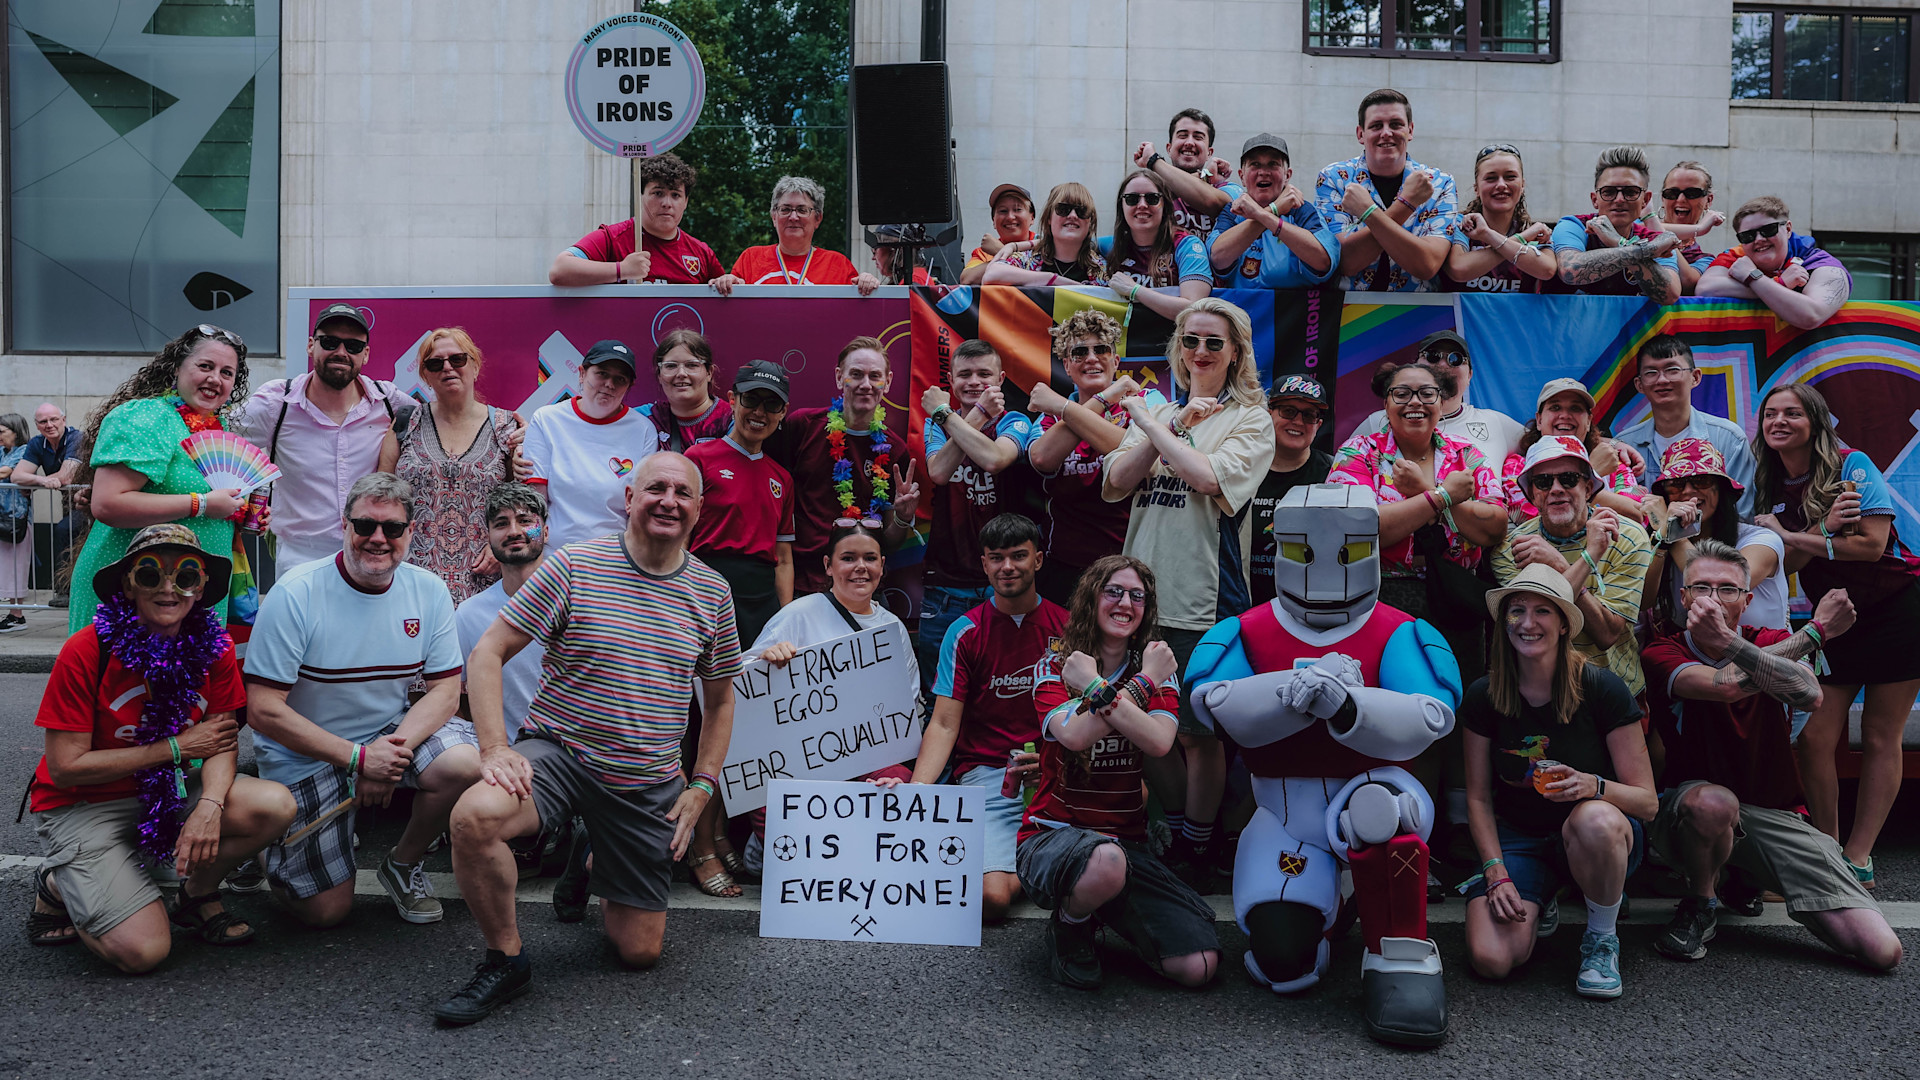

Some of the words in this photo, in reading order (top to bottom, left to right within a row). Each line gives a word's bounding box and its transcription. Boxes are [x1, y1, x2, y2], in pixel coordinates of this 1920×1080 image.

[583, 23, 606, 45] MANY
[606, 15, 638, 28] VOICES
[639, 16, 658, 27] ONE
[657, 21, 685, 43] FRONT
[597, 46, 671, 68] PRIDE
[618, 74, 650, 95] OF
[597, 101, 673, 122] IRONS
[1306, 290, 1320, 342] IRONS
[938, 326, 951, 393] AMMERS
[1305, 346, 1319, 368] OF
[753, 371, 781, 383] PELOTON
[1136, 491, 1187, 509] MTORS
[1260, 509, 1273, 518] AT
[733, 663, 772, 700] NLY
[788, 629, 893, 690] FRAGILE
[989, 674, 1033, 690] jobser
[774, 684, 838, 725] EGOS
[722, 750, 794, 800] FEAR
[802, 708, 915, 770] EQUALITY
[783, 793, 974, 823] FOOTBALL
[805, 834, 840, 860] IS
[780, 874, 968, 910] EVERYONE!
